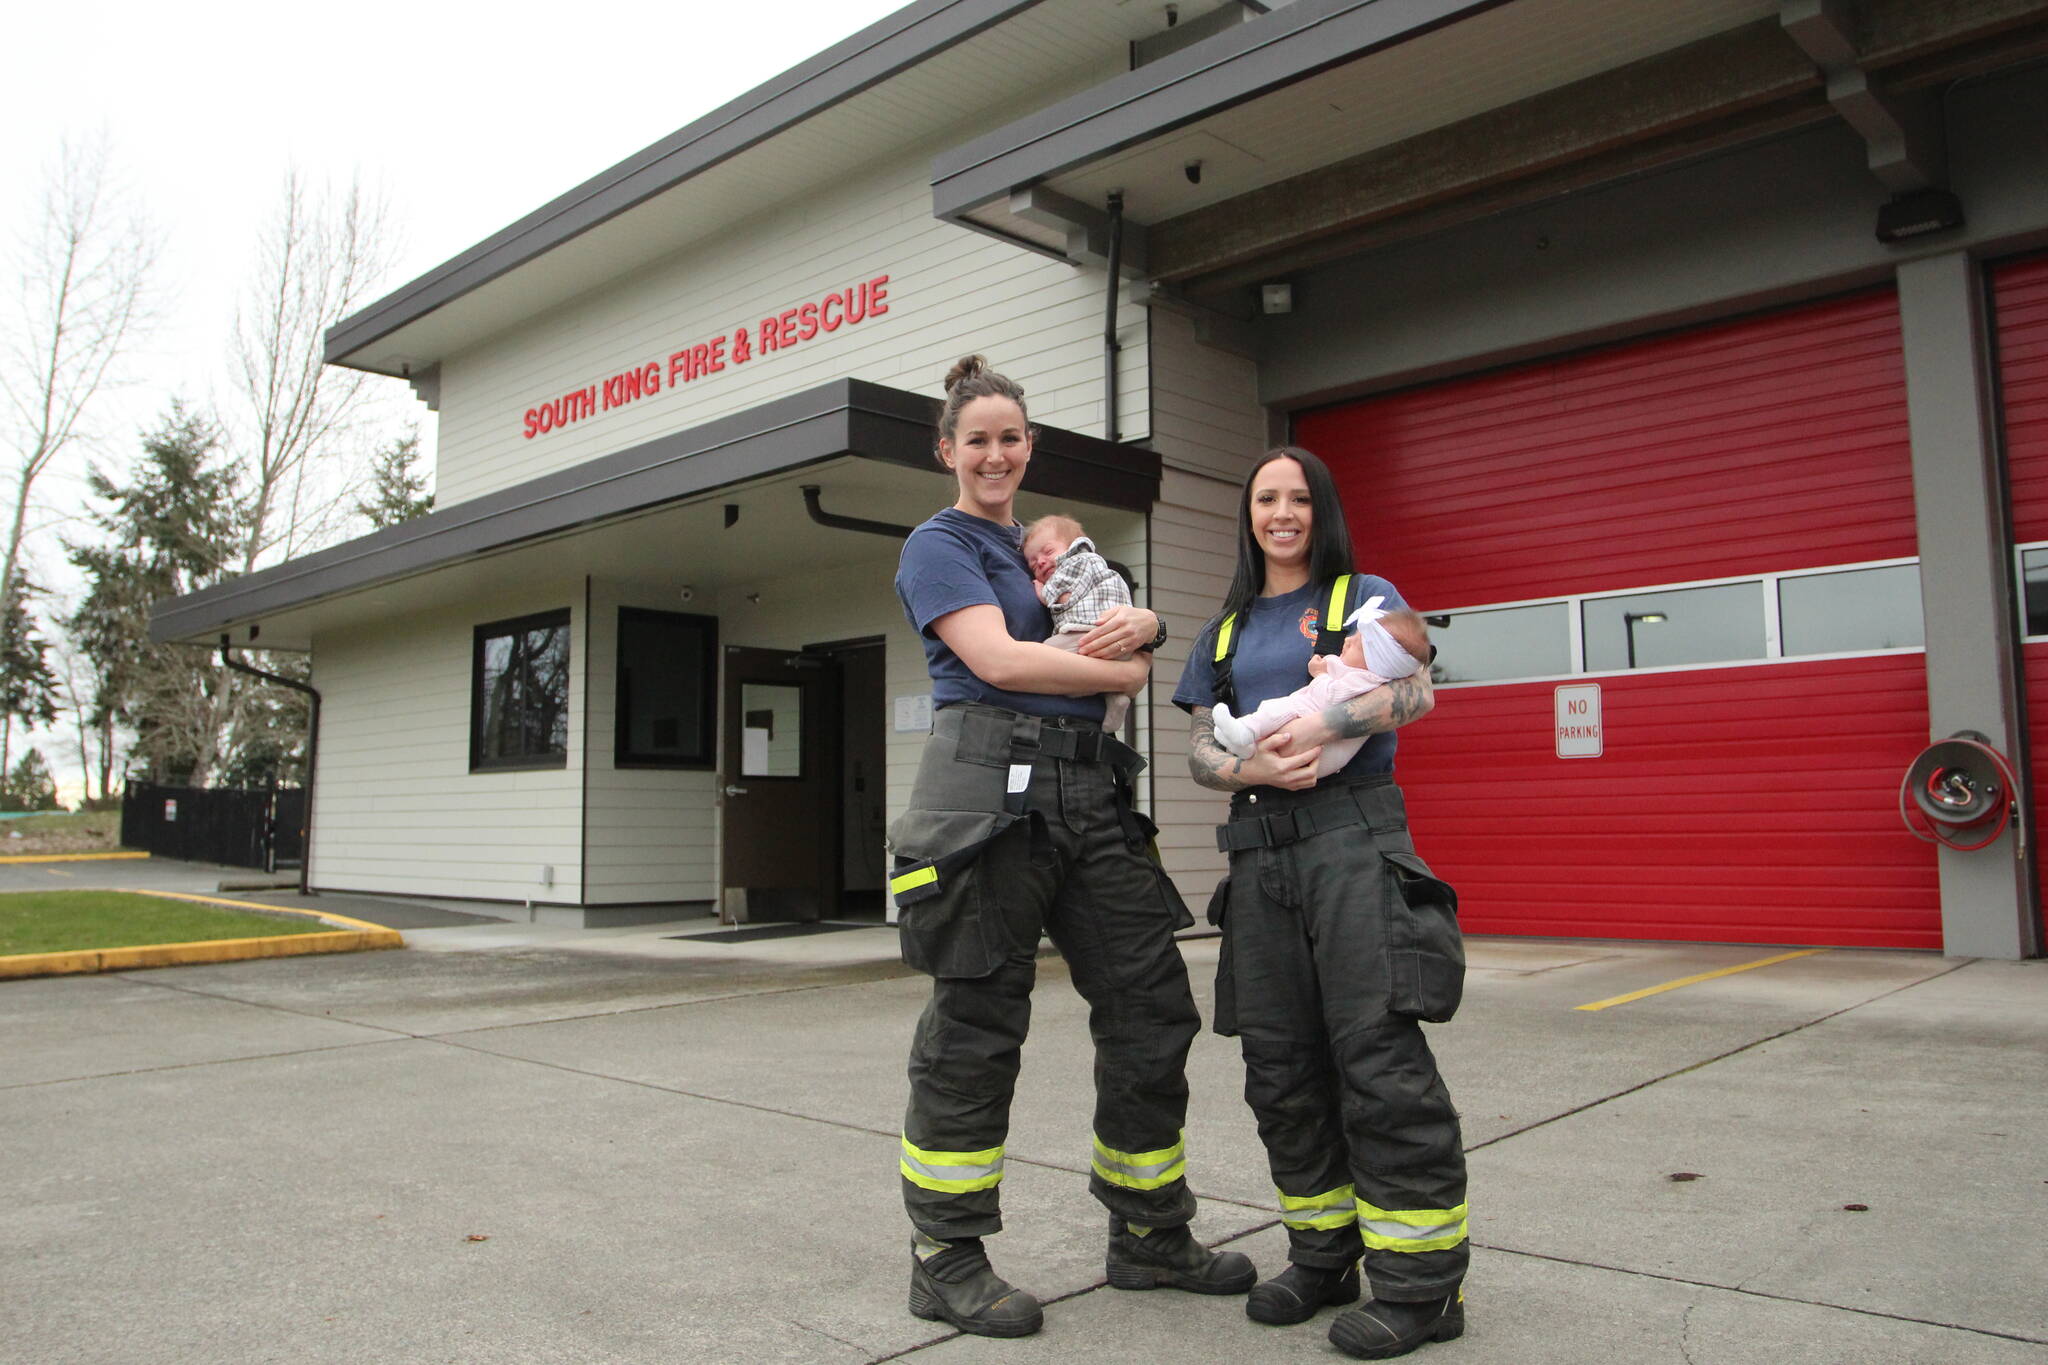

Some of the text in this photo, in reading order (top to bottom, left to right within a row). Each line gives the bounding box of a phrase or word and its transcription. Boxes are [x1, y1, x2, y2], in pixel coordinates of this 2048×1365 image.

[522, 274, 890, 440] SOUTH KING FIRE & RESCUE
[1568, 699, 1588, 714] NO
[1559, 725, 1599, 739] PARKING
